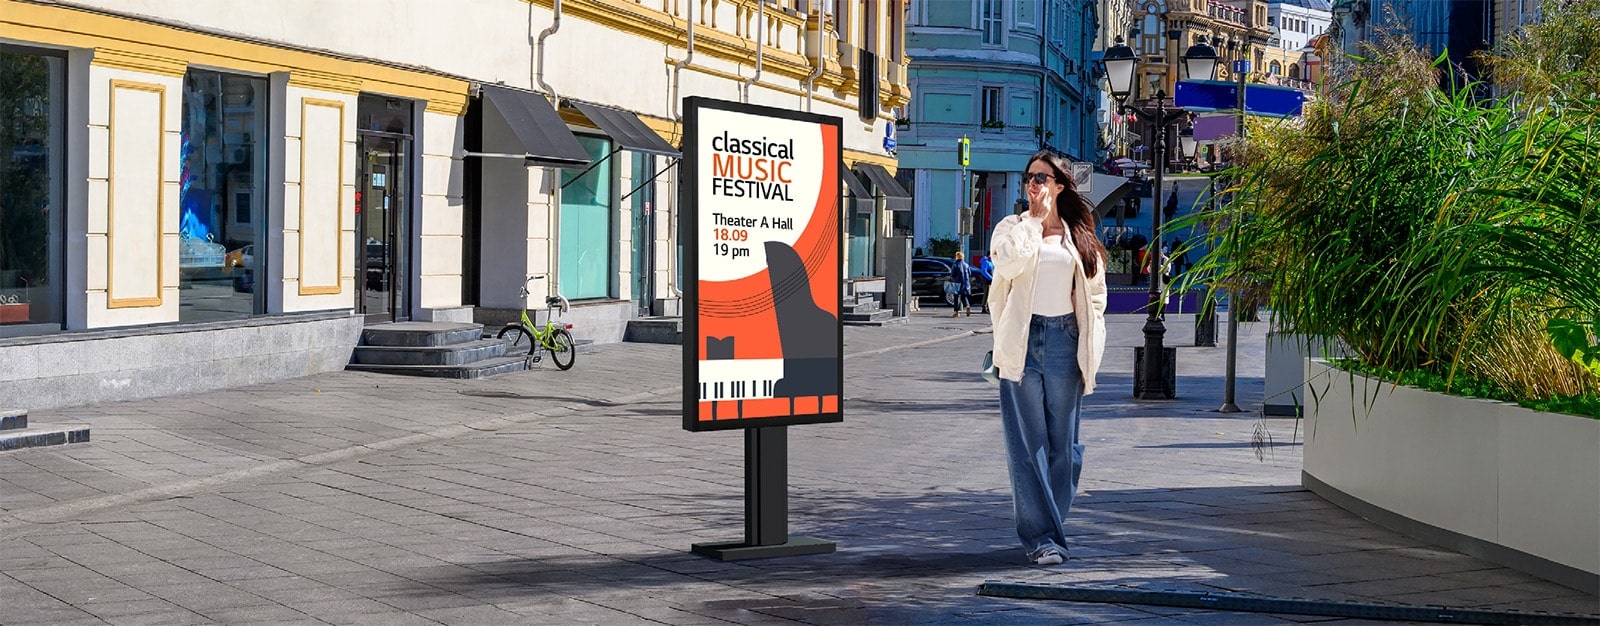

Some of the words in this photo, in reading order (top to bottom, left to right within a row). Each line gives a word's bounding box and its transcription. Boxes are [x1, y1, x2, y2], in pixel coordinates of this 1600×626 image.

[712, 130, 794, 160] classical
[713, 153, 792, 184] MUSIC
[712, 178, 794, 202] FESTIVAL
[712, 212, 757, 228] Theater
[760, 216, 769, 229] A
[772, 217, 793, 231] Hall
[713, 228, 748, 242] 18.09
[713, 243, 729, 257] 19
[732, 247, 750, 260] pm
